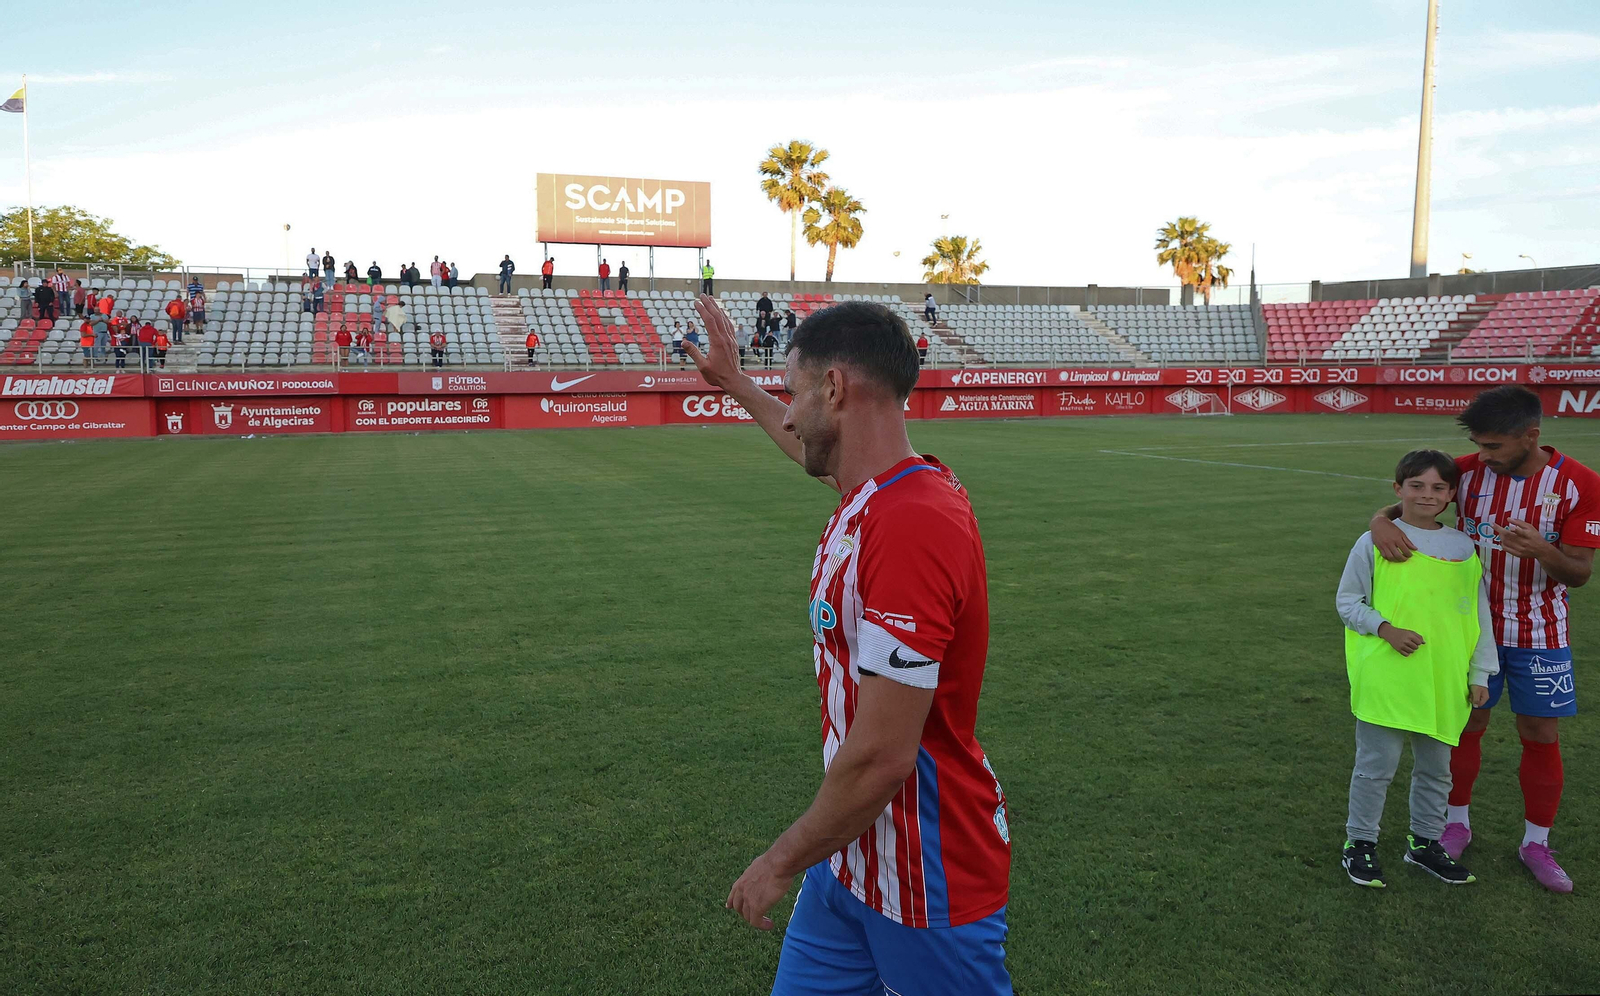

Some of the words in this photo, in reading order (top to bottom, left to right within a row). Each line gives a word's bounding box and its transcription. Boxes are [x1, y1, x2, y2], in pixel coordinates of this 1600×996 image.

[564, 183, 686, 214] SCAMP
[575, 215, 615, 225] Sustainable
[645, 219, 676, 227] Solutions
[448, 375, 486, 385] FÚTBOL
[962, 371, 1043, 385] CAPENERGY
[1069, 371, 1109, 384] Limpiasol
[1121, 370, 1161, 384] Limpiasol
[1186, 369, 1212, 383] EXO
[1253, 369, 1283, 383] EXO
[1290, 368, 1320, 383] EXO
[1327, 368, 1358, 383] EXO
[1400, 368, 1445, 382] ICOM
[1468, 367, 1517, 382] ICOM
[2, 376, 115, 396] Lavahostel
[281, 379, 334, 389] PODOLOGÍA
[958, 401, 990, 411] AGUA
[991, 400, 1035, 411] MARINA
[1056, 391, 1097, 406] Frida
[1105, 391, 1145, 406] KAHLO
[1394, 397, 1413, 407] LA
[1415, 397, 1471, 408] ESQUIN
[240, 405, 321, 418] Ayuntamiento
[387, 398, 462, 415] populares
[248, 417, 261, 427] de
[262, 416, 315, 429] Algeciras
[355, 418, 377, 426] CON
[378, 417, 390, 425] EL
[391, 416, 432, 425] DEPORTE
[434, 414, 490, 424] ALGECIREÑO
[591, 414, 628, 424] Algeciras
[29, 422, 66, 432] Campo
[68, 421, 81, 430] de
[82, 421, 126, 430] Gibraltar
